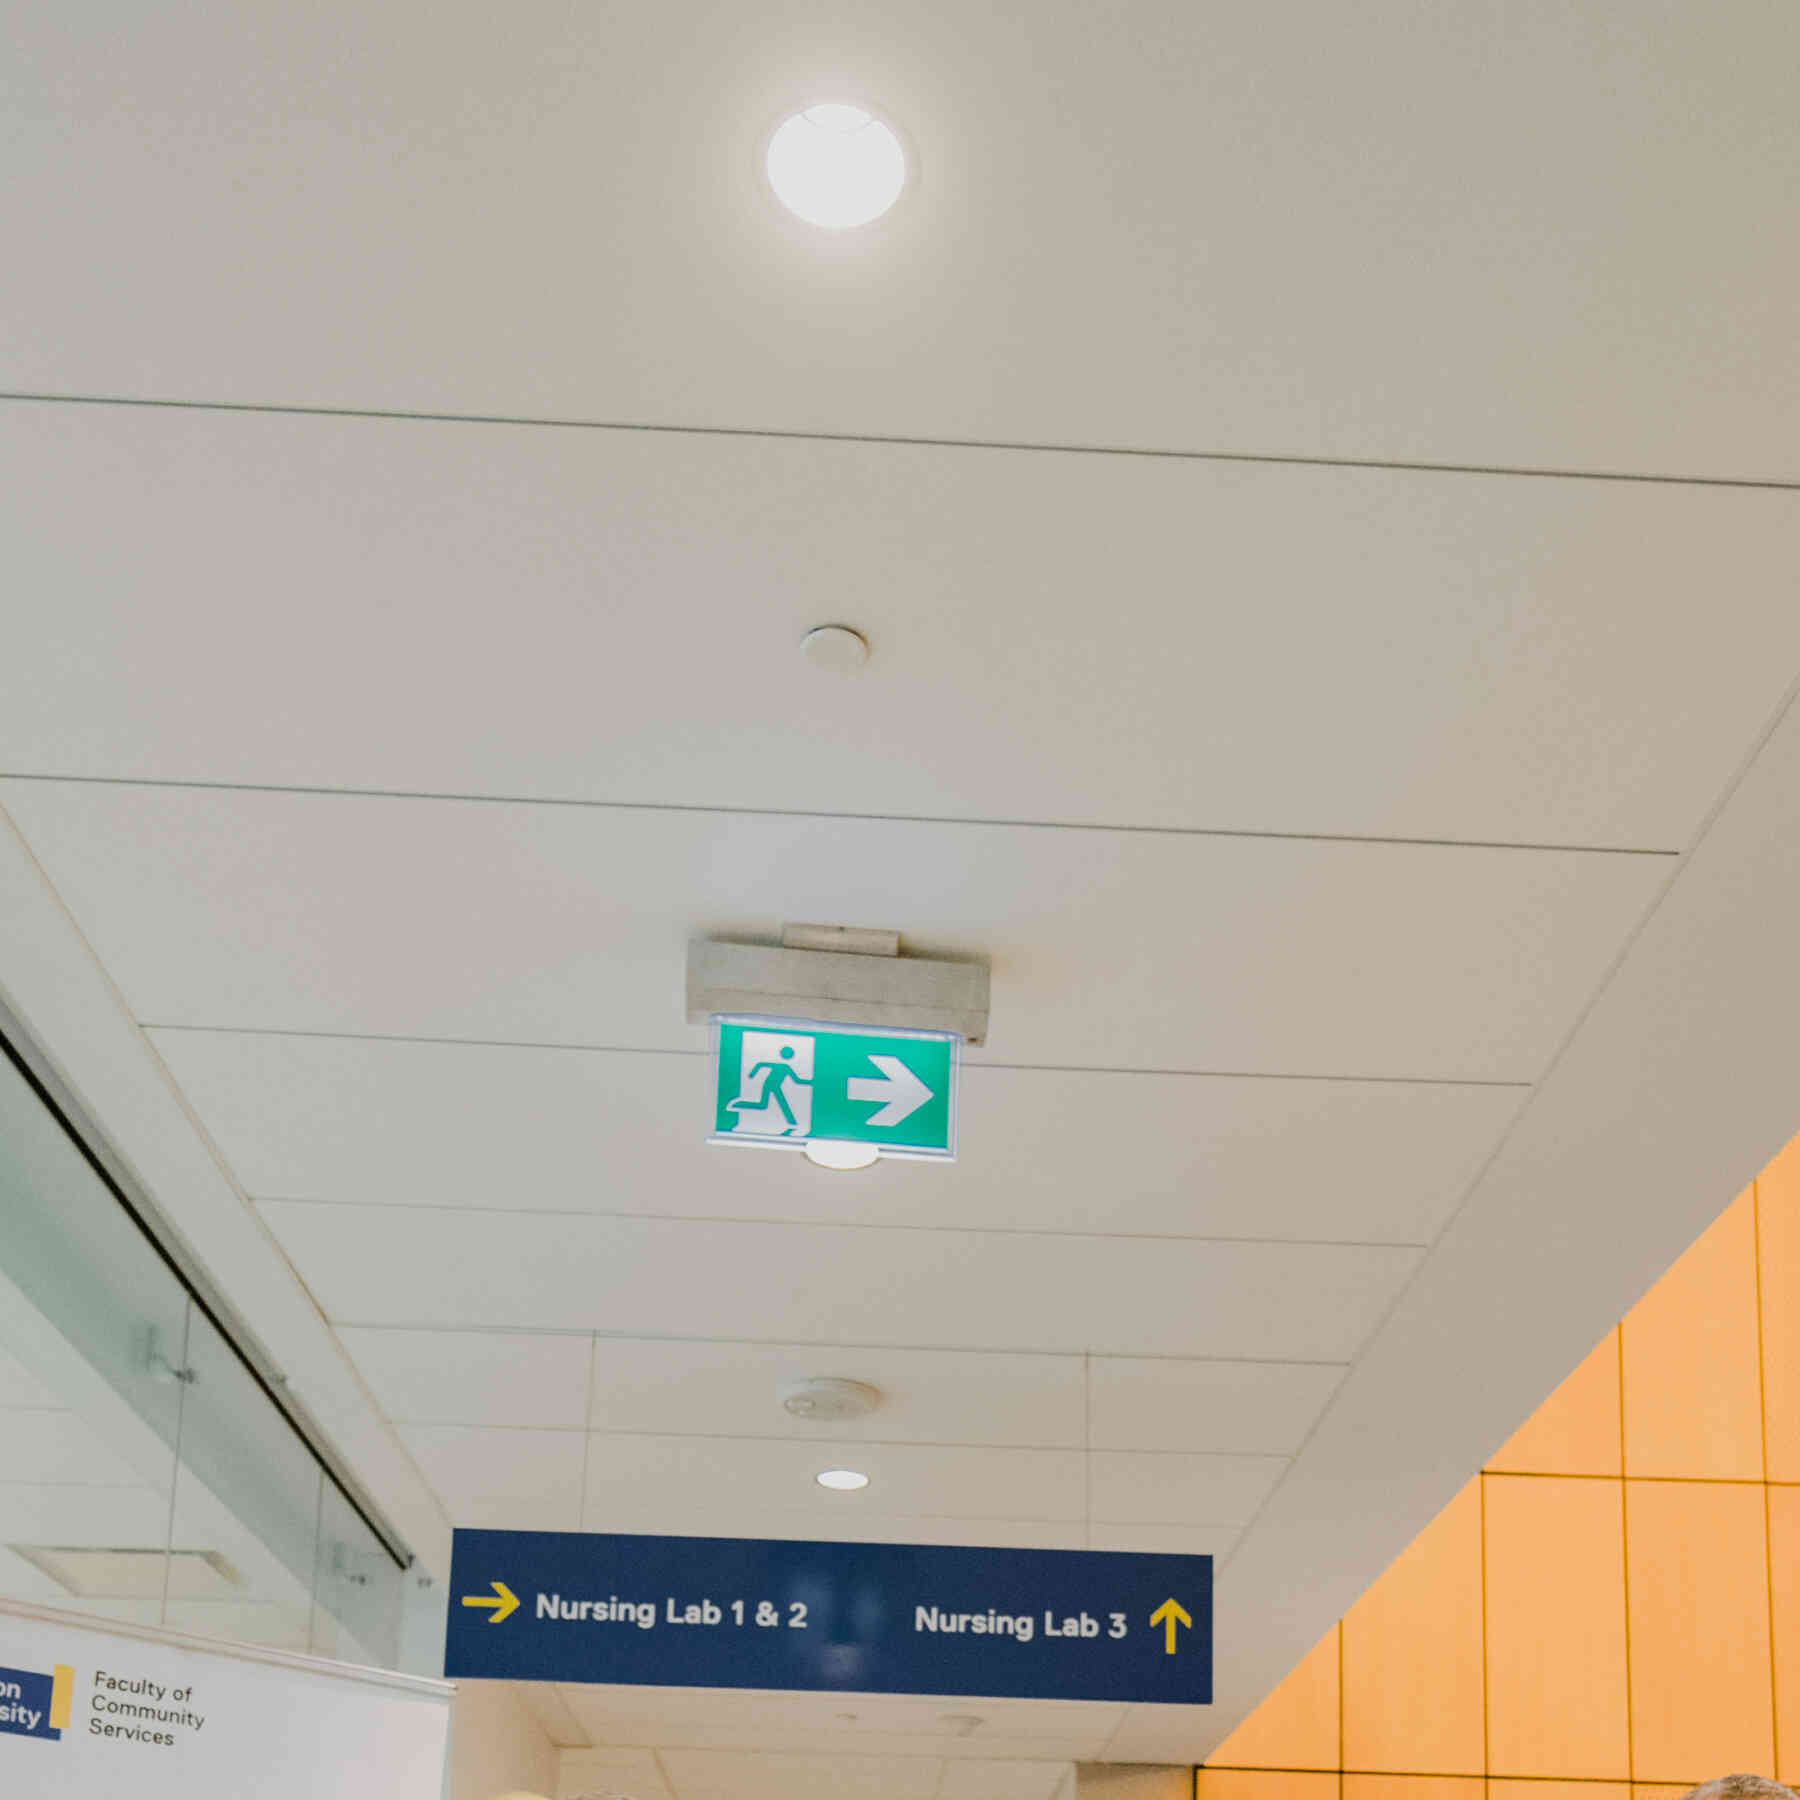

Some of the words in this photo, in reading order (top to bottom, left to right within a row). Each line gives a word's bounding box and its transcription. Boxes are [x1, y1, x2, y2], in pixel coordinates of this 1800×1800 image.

[536, 1593, 656, 1629] Nursing
[666, 1598, 723, 1625] Lab
[731, 1600, 744, 1626] 1
[755, 1601, 779, 1627] &
[788, 1602, 808, 1629] 2
[914, 1605, 1034, 1642] Nursing
[1045, 1610, 1100, 1638] Lab
[1108, 1612, 1128, 1639] 3
[94, 1670, 166, 1701] Faculty
[172, 1687, 193, 1702] of
[91, 1694, 206, 1731] Community
[88, 1717, 175, 1746] Services
